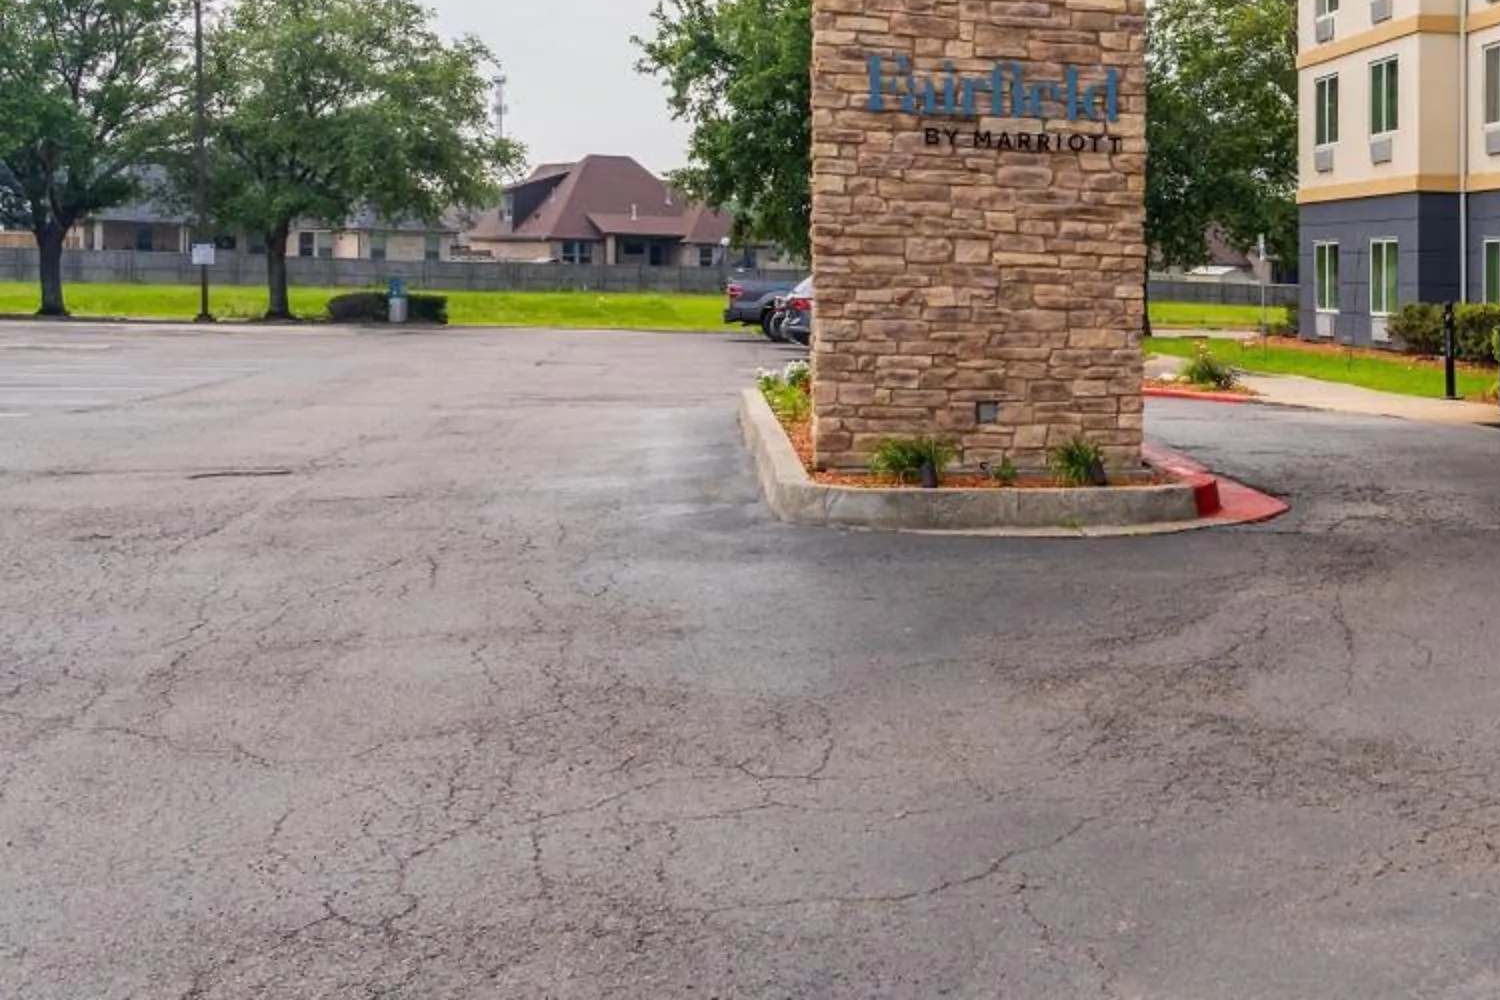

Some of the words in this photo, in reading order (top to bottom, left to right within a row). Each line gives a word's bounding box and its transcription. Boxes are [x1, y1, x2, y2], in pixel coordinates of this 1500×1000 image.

[866, 54, 1119, 122] Fairfield
[925, 127, 959, 146] BY
[973, 130, 1122, 154] MARRIOTT
